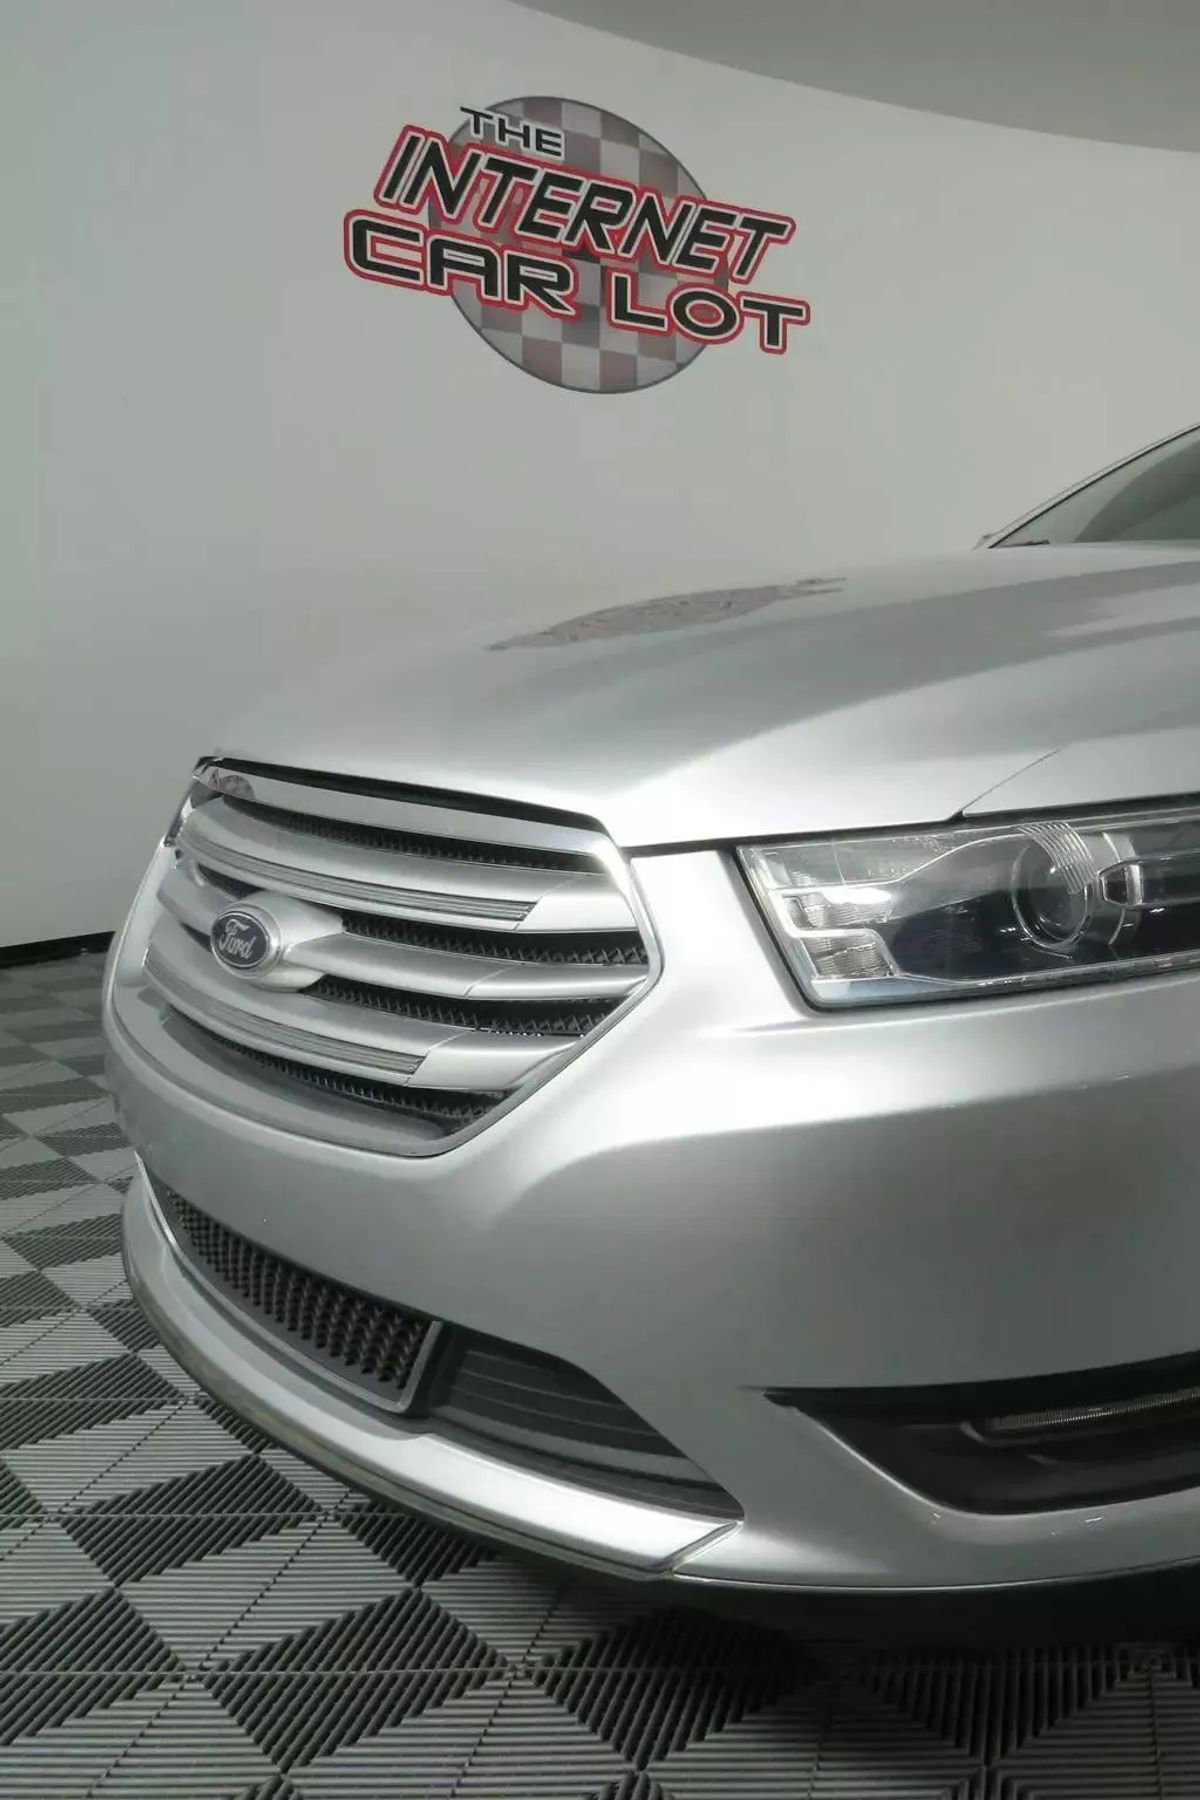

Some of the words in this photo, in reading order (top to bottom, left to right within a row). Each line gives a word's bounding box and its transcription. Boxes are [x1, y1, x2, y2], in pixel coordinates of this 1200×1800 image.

[459, 106, 564, 157] THE
[378, 130, 792, 281] INTERNET
[348, 214, 577, 318] CAR
[610, 271, 806, 350] LOT
[219, 918, 258, 960] Ford
